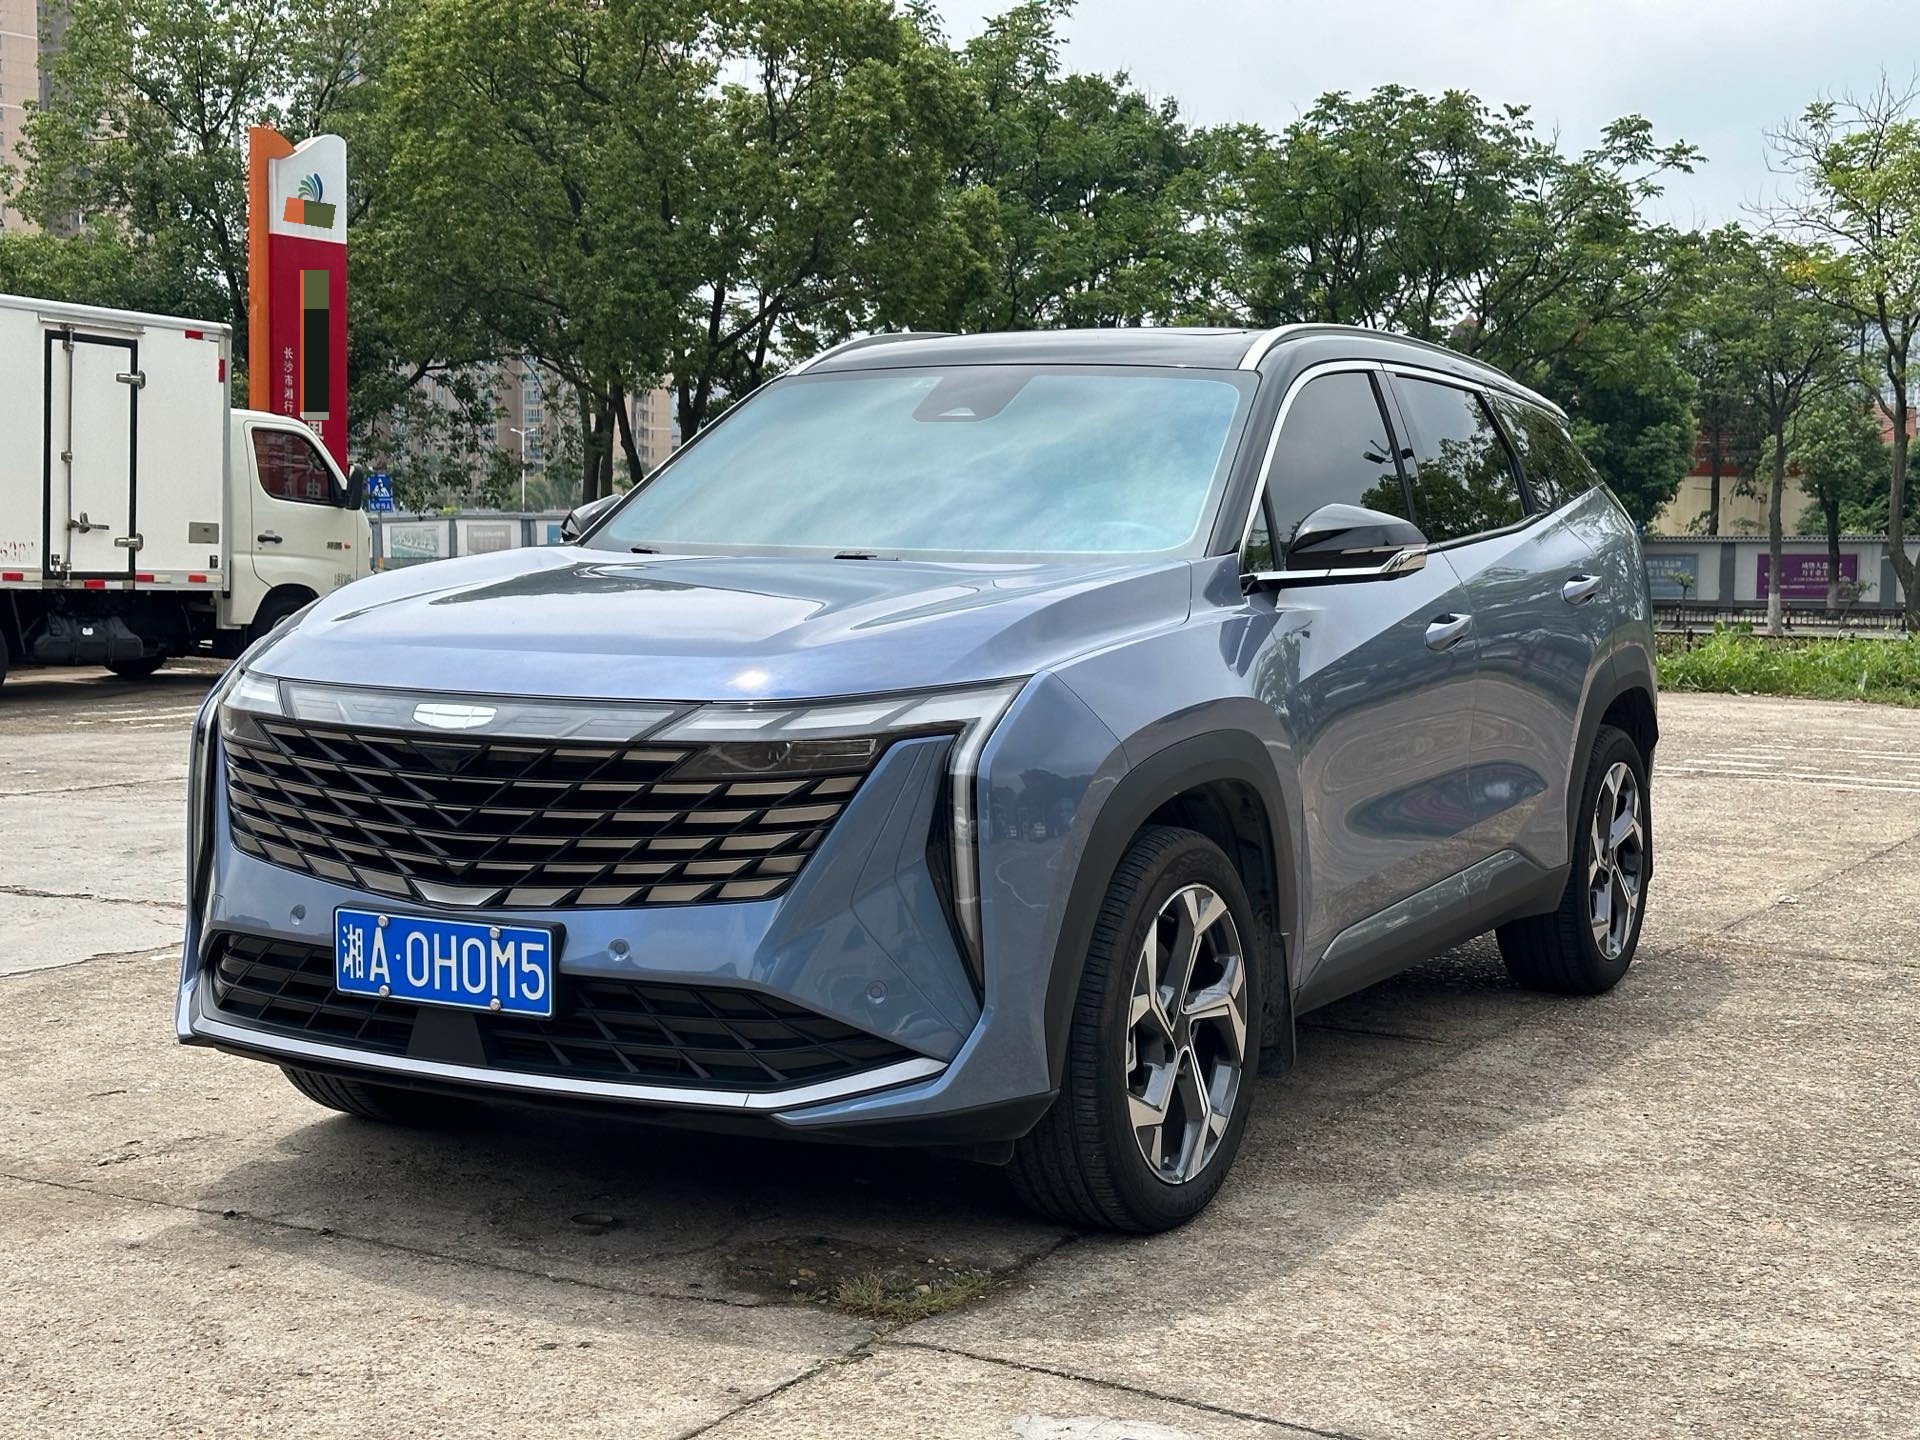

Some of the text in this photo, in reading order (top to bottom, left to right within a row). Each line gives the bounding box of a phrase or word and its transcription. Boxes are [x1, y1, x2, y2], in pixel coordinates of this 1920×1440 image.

[283, 346, 294, 416] 长沙市湘行
